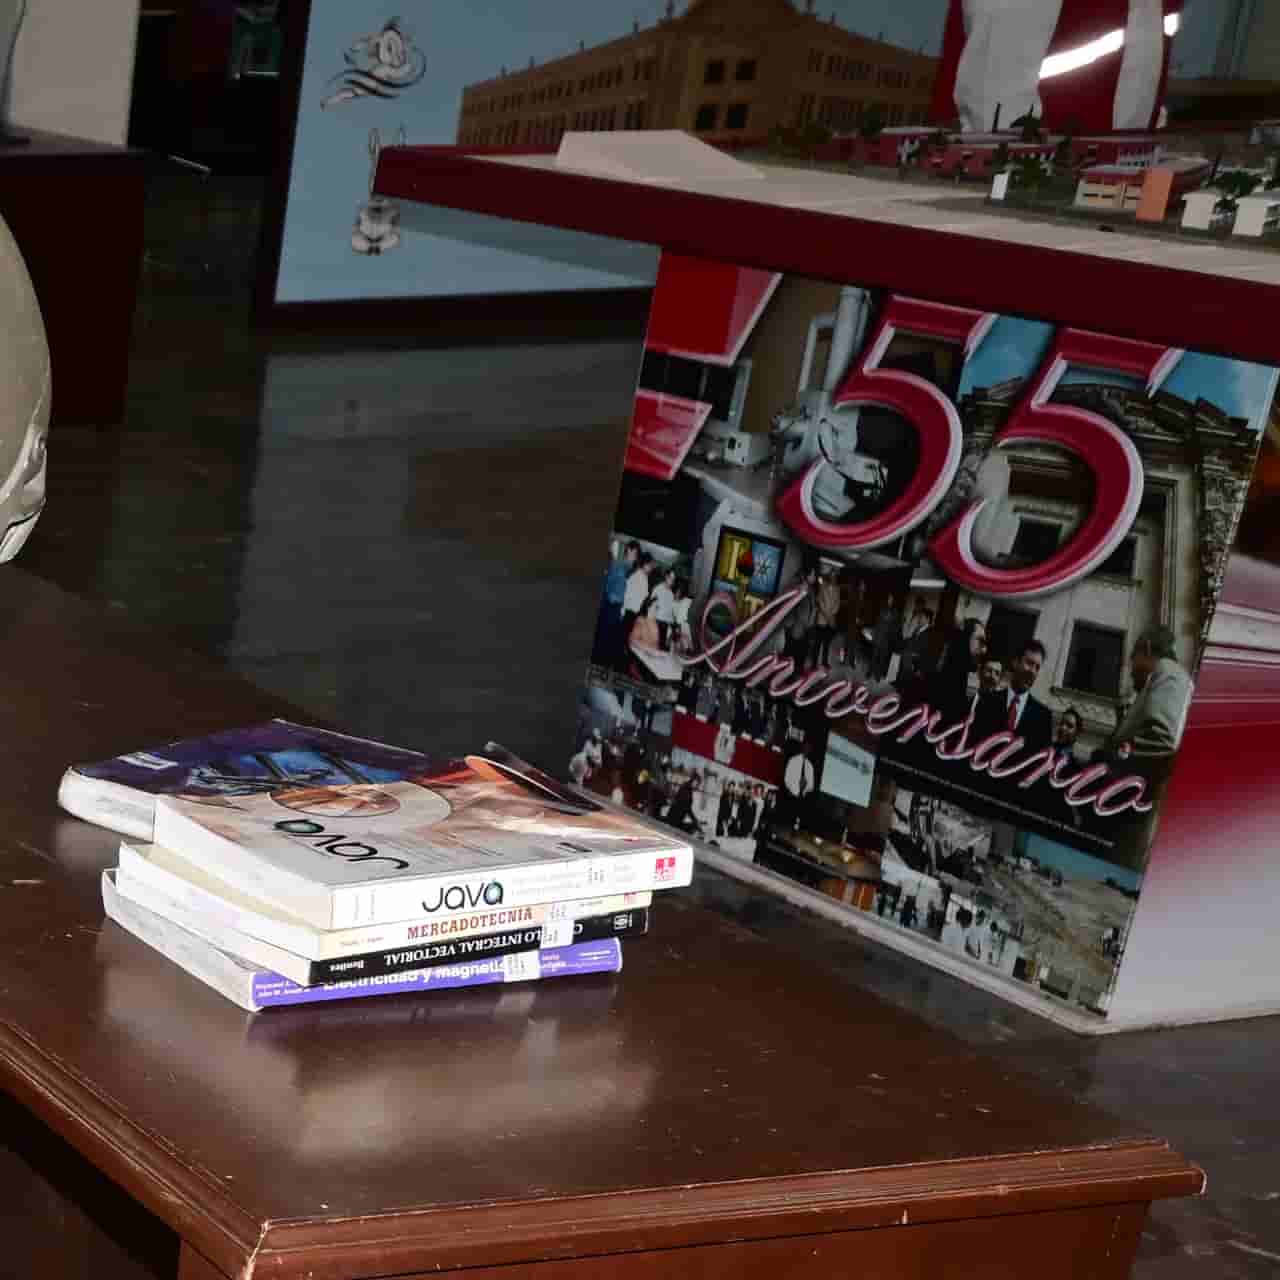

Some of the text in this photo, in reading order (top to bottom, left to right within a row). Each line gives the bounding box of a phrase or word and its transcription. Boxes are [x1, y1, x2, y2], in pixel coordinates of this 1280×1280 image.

[774, 295, 1185, 598] 55
[676, 588, 1153, 818] Aniversario
[407, 907, 533, 940] MERCADOTECNIA
[384, 941, 456, 966] VECTORIAL
[460, 931, 522, 955] INTEGRAL
[421, 967, 434, 983] y
